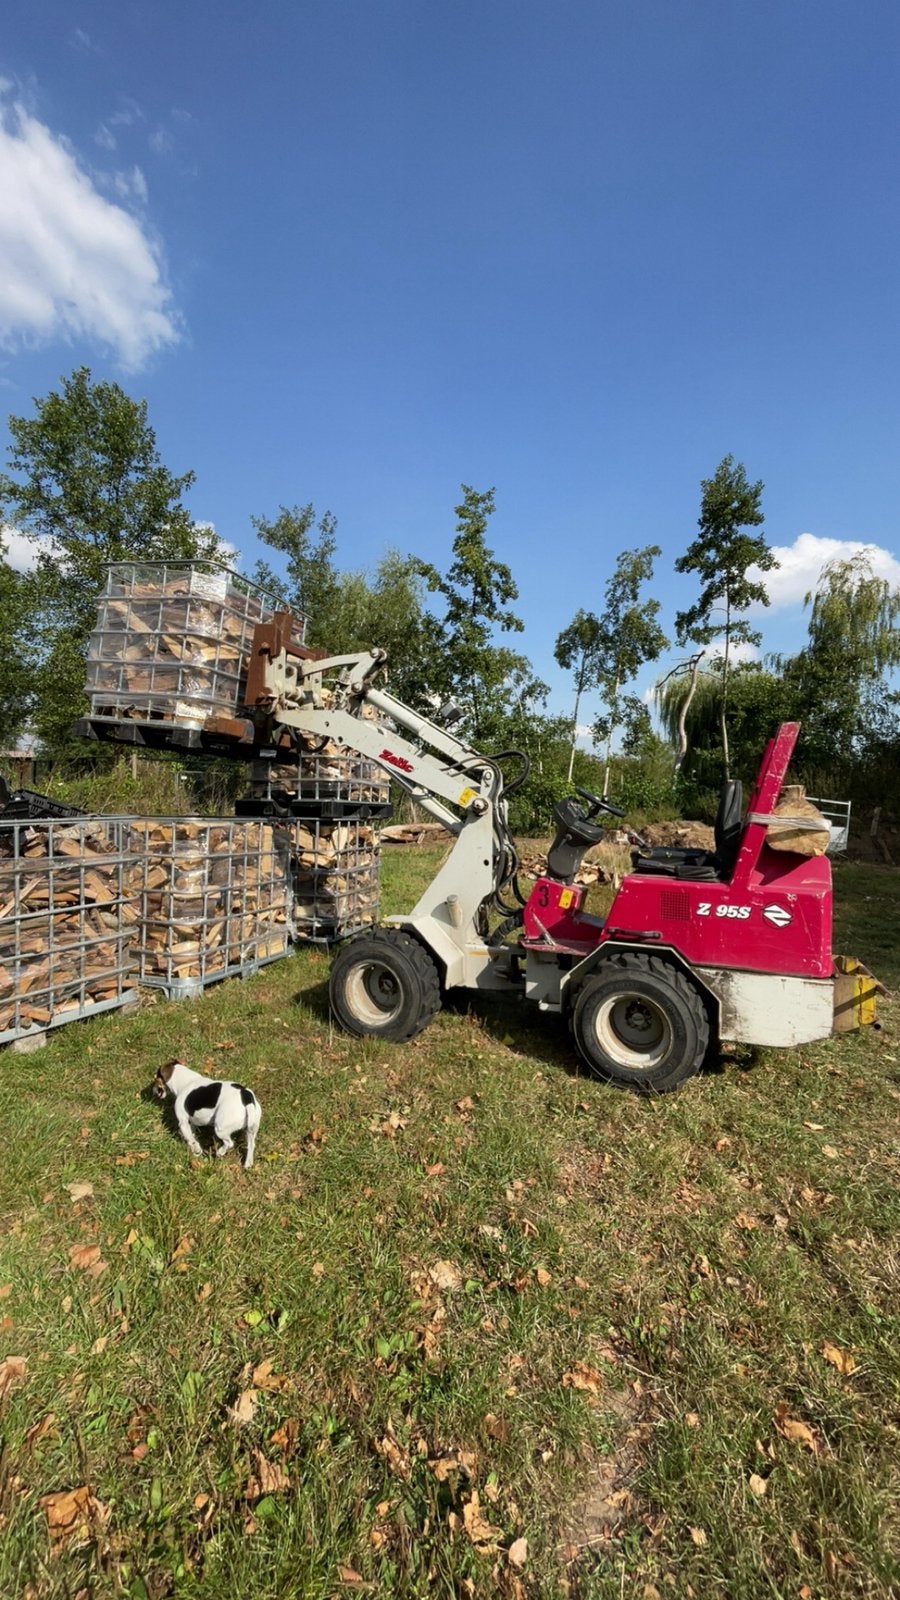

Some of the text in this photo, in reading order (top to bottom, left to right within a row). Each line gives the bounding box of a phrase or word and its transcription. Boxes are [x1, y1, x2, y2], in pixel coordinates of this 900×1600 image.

[538, 886, 549, 908] 3
[696, 902, 752, 919] Z 95S
